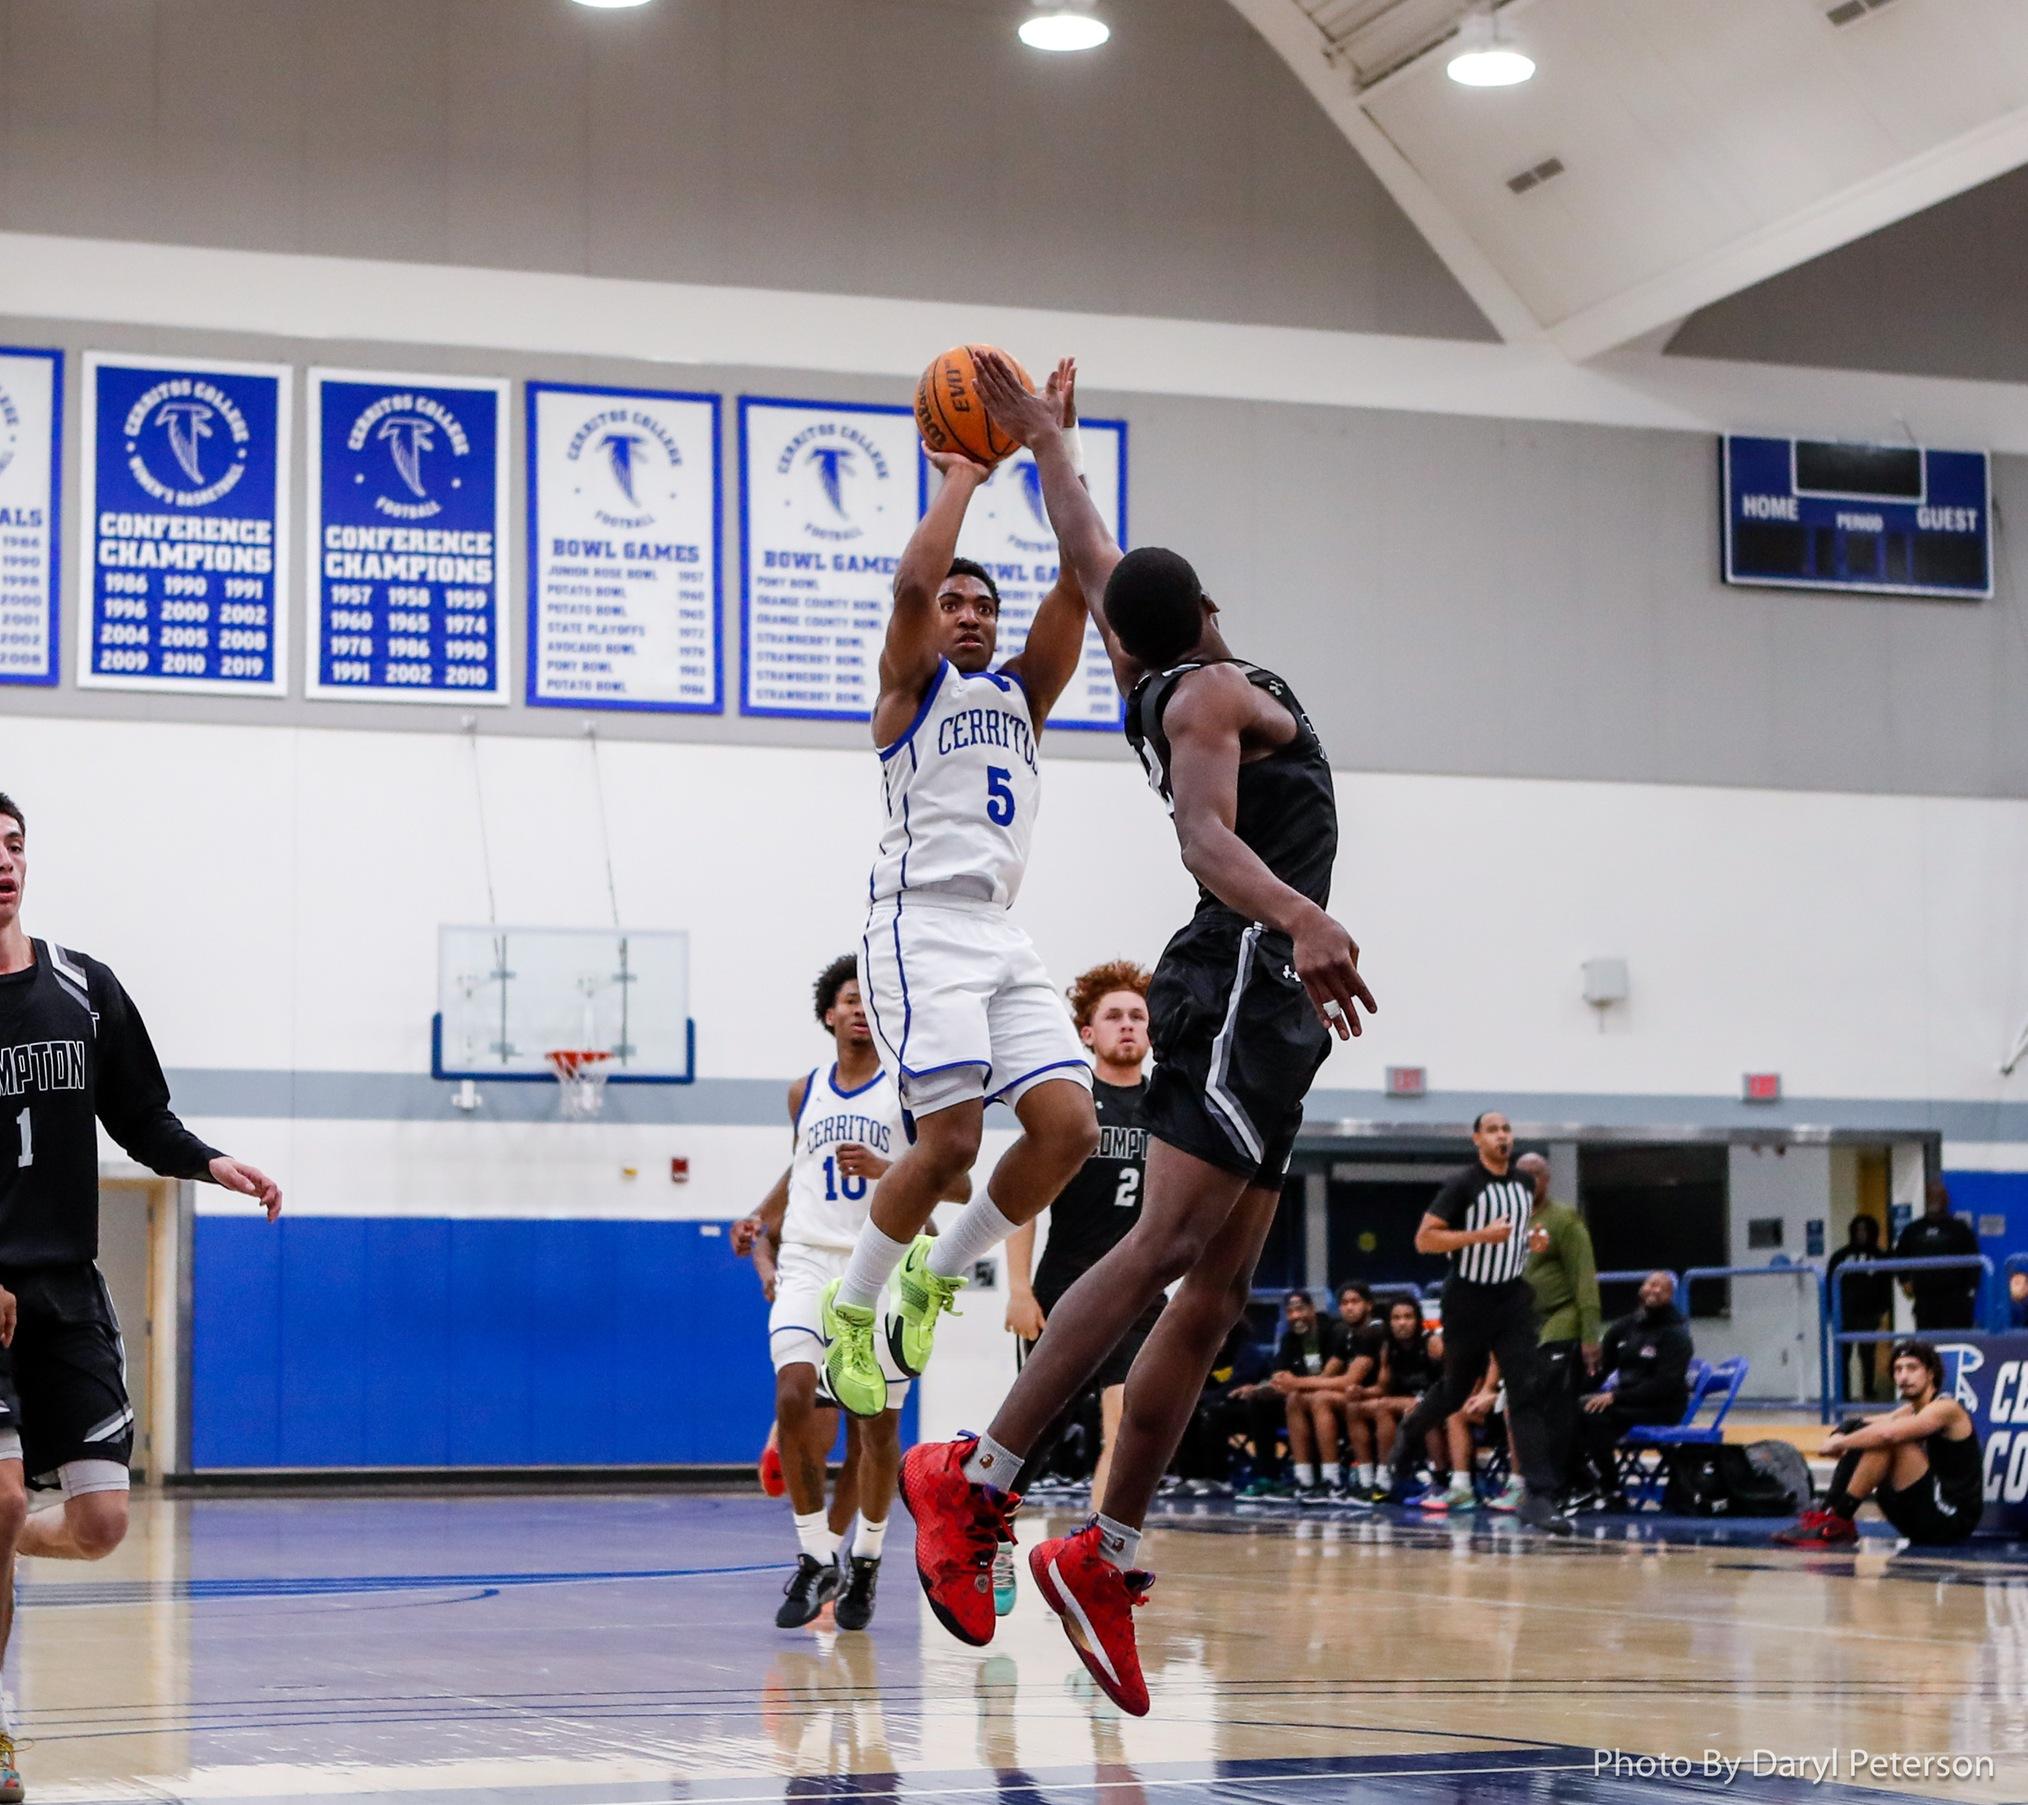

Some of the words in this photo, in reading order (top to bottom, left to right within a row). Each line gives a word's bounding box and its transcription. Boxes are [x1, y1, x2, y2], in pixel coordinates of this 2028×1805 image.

[194, 381, 250, 443] COLLEGE
[414, 395, 470, 457] COLLEGE
[633, 412, 683, 466] COLLEGE
[375, 495, 443, 519] FOOTBALL
[1742, 494, 1799, 521] HOME
[100, 512, 272, 544] CONFERENCE
[1916, 507, 1978, 533] GUEST
[325, 525, 493, 555] CONFERENCE
[552, 539, 616, 558] BOWL
[623, 542, 700, 563] GAMES
[99, 539, 272, 574] CHAMPIONS
[325, 553, 493, 584] CHAMPIONS
[764, 550, 826, 571] BOWL
[627, 569, 658, 580] BOWL
[790, 578, 819, 589] BOWL
[983, 563, 1029, 581] OWL
[164, 574, 208, 597] 1990
[225, 577, 263, 599] 1991
[331, 584, 373, 606] 1957
[445, 589, 487, 610] 1959
[547, 584, 592, 595] POTATO
[596, 586, 626, 598] BOWL
[160, 600, 209, 622] 2000
[219, 603, 267, 625] 2002
[547, 603, 592, 614] POTATO
[596, 605, 627, 617] BOWL
[853, 600, 882, 612] BOWL
[101, 623, 149, 645] 2004
[445, 614, 487, 635] 1974
[548, 622, 582, 633] STATE
[587, 624, 645, 636] PLAYOFFS
[853, 619, 882, 631] BOWL
[548, 641, 601, 653] AVOCADO
[606, 644, 637, 655] BOWL
[835, 637, 865, 648] BOWL
[100, 650, 149, 671] 2009
[162, 652, 206, 675] 2010
[220, 656, 264, 677] 2019
[582, 661, 612, 673] BOWL
[835, 655, 865, 666] BOWL
[332, 661, 371, 682] 1991
[386, 662, 432, 684] 2002
[445, 665, 488, 687] 2010
[547, 679, 591, 691] POTATO
[596, 681, 627, 692] BOWL
[835, 673, 865, 685] BOWL
[835, 692, 865, 703] BOWL
[986, 765, 1016, 827] 5
[16, 1106, 34, 1168] 1
[807, 1114, 891, 1154] CERRITOS
[1089, 1126, 1151, 1160] OMPT
[1114, 1167, 1140, 1207] 2
